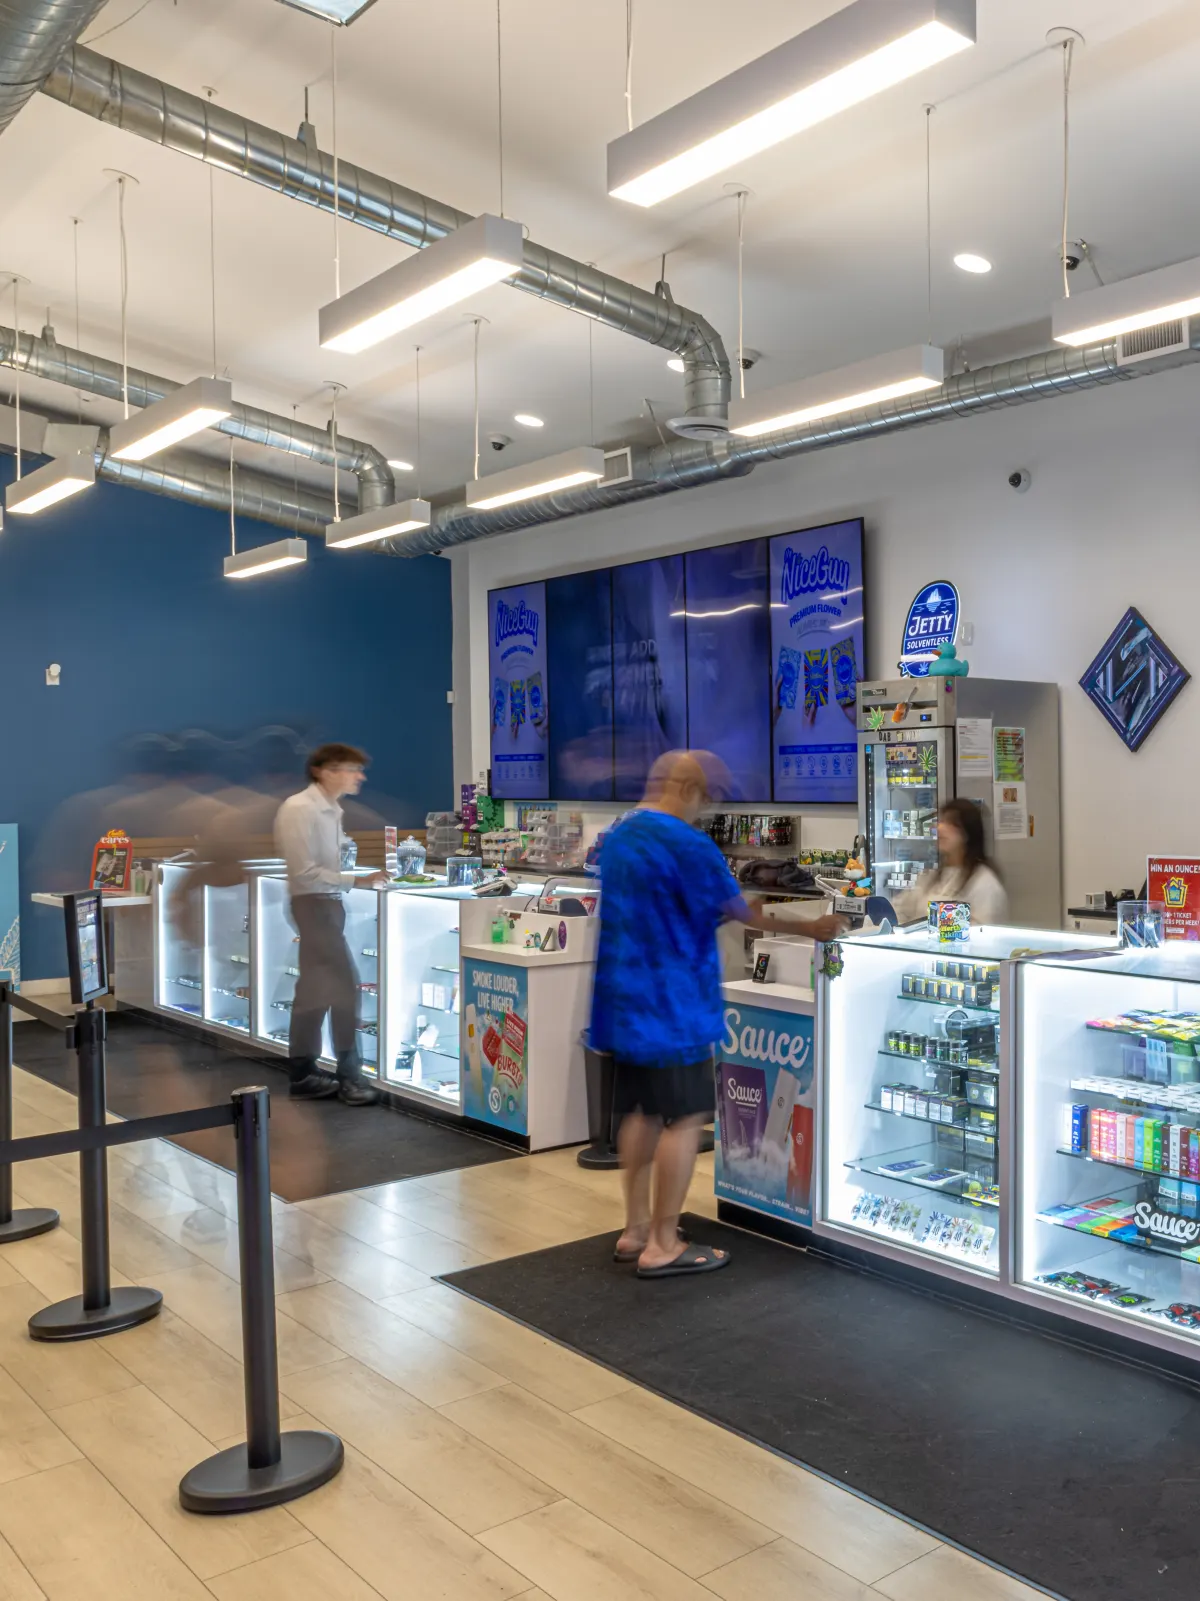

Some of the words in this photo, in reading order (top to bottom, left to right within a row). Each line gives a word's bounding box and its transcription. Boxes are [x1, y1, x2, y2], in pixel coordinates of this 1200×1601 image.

[781, 546, 850, 606] NiceGuy
[496, 600, 539, 648] NiceGuy
[789, 605, 817, 628] PREMIUM
[817, 603, 842, 617] FLOWER
[908, 610, 953, 637] JETTY
[906, 636, 950, 650] SOLVENTLESS
[1150, 863, 1163, 873] WIN
[1163, 864, 1174, 873] AN
[1175, 864, 1200, 874] OUNCE!
[472, 970, 492, 989] SMOKE
[493, 973, 519, 997] LOUDER,
[478, 991, 490, 1009] LIVE
[491, 994, 514, 1014] HIGHER
[719, 1008, 812, 1068] Sauce
[727, 1077, 763, 1104] Sauce
[717, 1180, 735, 1191] WHAT'S
[735, 1186, 748, 1195] YOUR
[1133, 1201, 1200, 1241] Sauce
